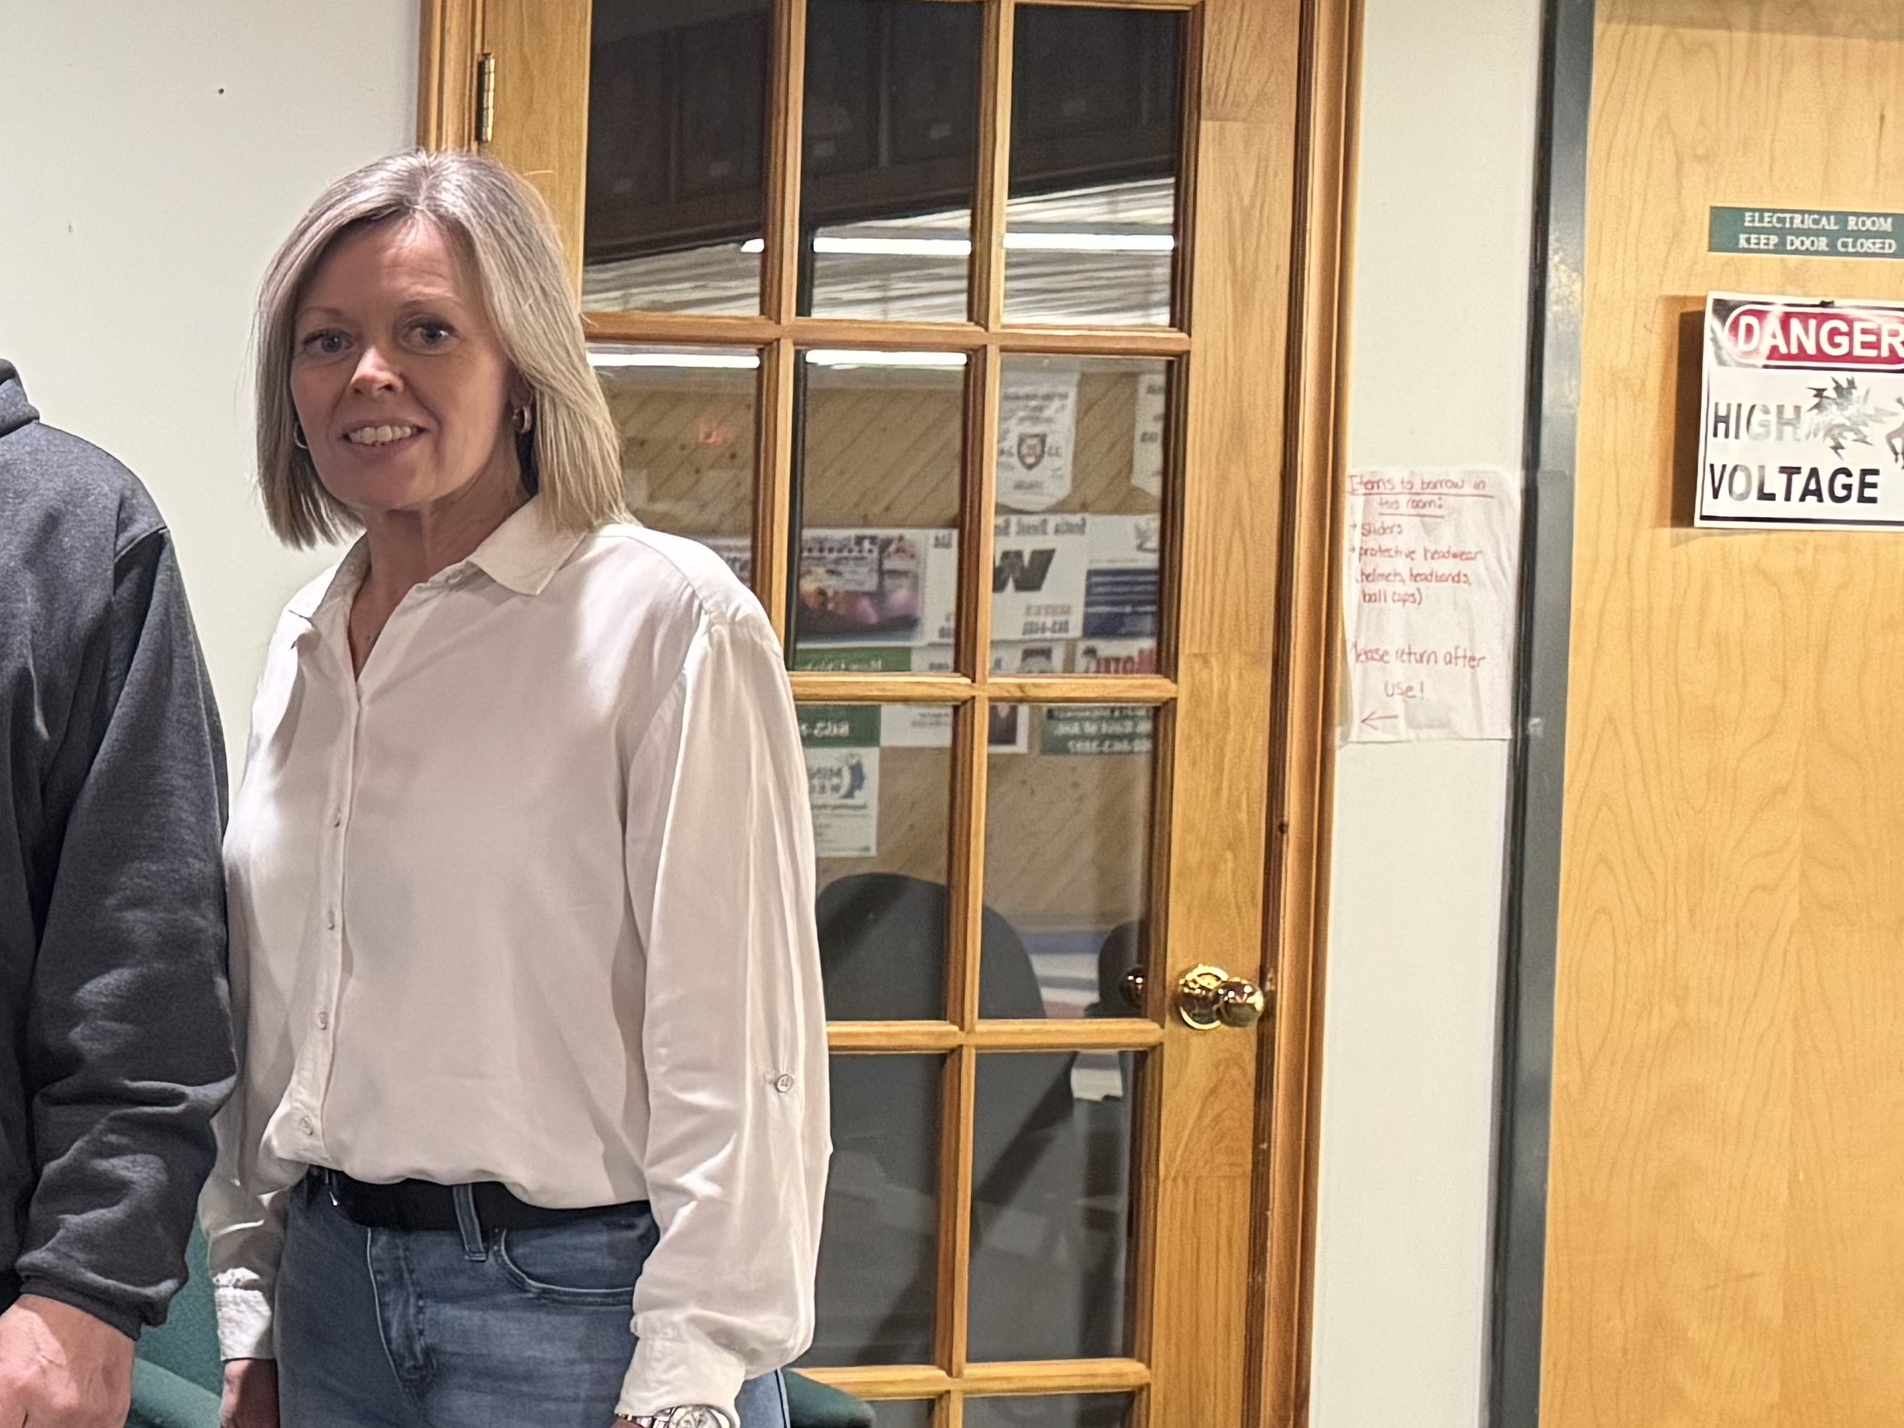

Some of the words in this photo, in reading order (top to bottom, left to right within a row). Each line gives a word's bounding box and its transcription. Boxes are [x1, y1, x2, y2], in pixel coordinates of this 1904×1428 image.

[1743, 211, 1839, 231] ELECTRICAL
[1847, 215, 1893, 233] ROOM
[1738, 233, 1779, 250] KEEP
[1786, 235, 1829, 252] DOOR
[1837, 237, 1897, 254] CLOSED
[1736, 314, 1904, 359] DANGER
[1712, 402, 1803, 442] HIGH
[1401, 477, 1413, 490] to
[1421, 476, 1464, 491] borrow
[1473, 479, 1486, 490] in
[1708, 463, 1881, 505] VOLTAGE
[1362, 588, 1387, 603] ball
[1348, 640, 1390, 664] lease
[1395, 644, 1438, 665] return
[1443, 645, 1485, 669] after
